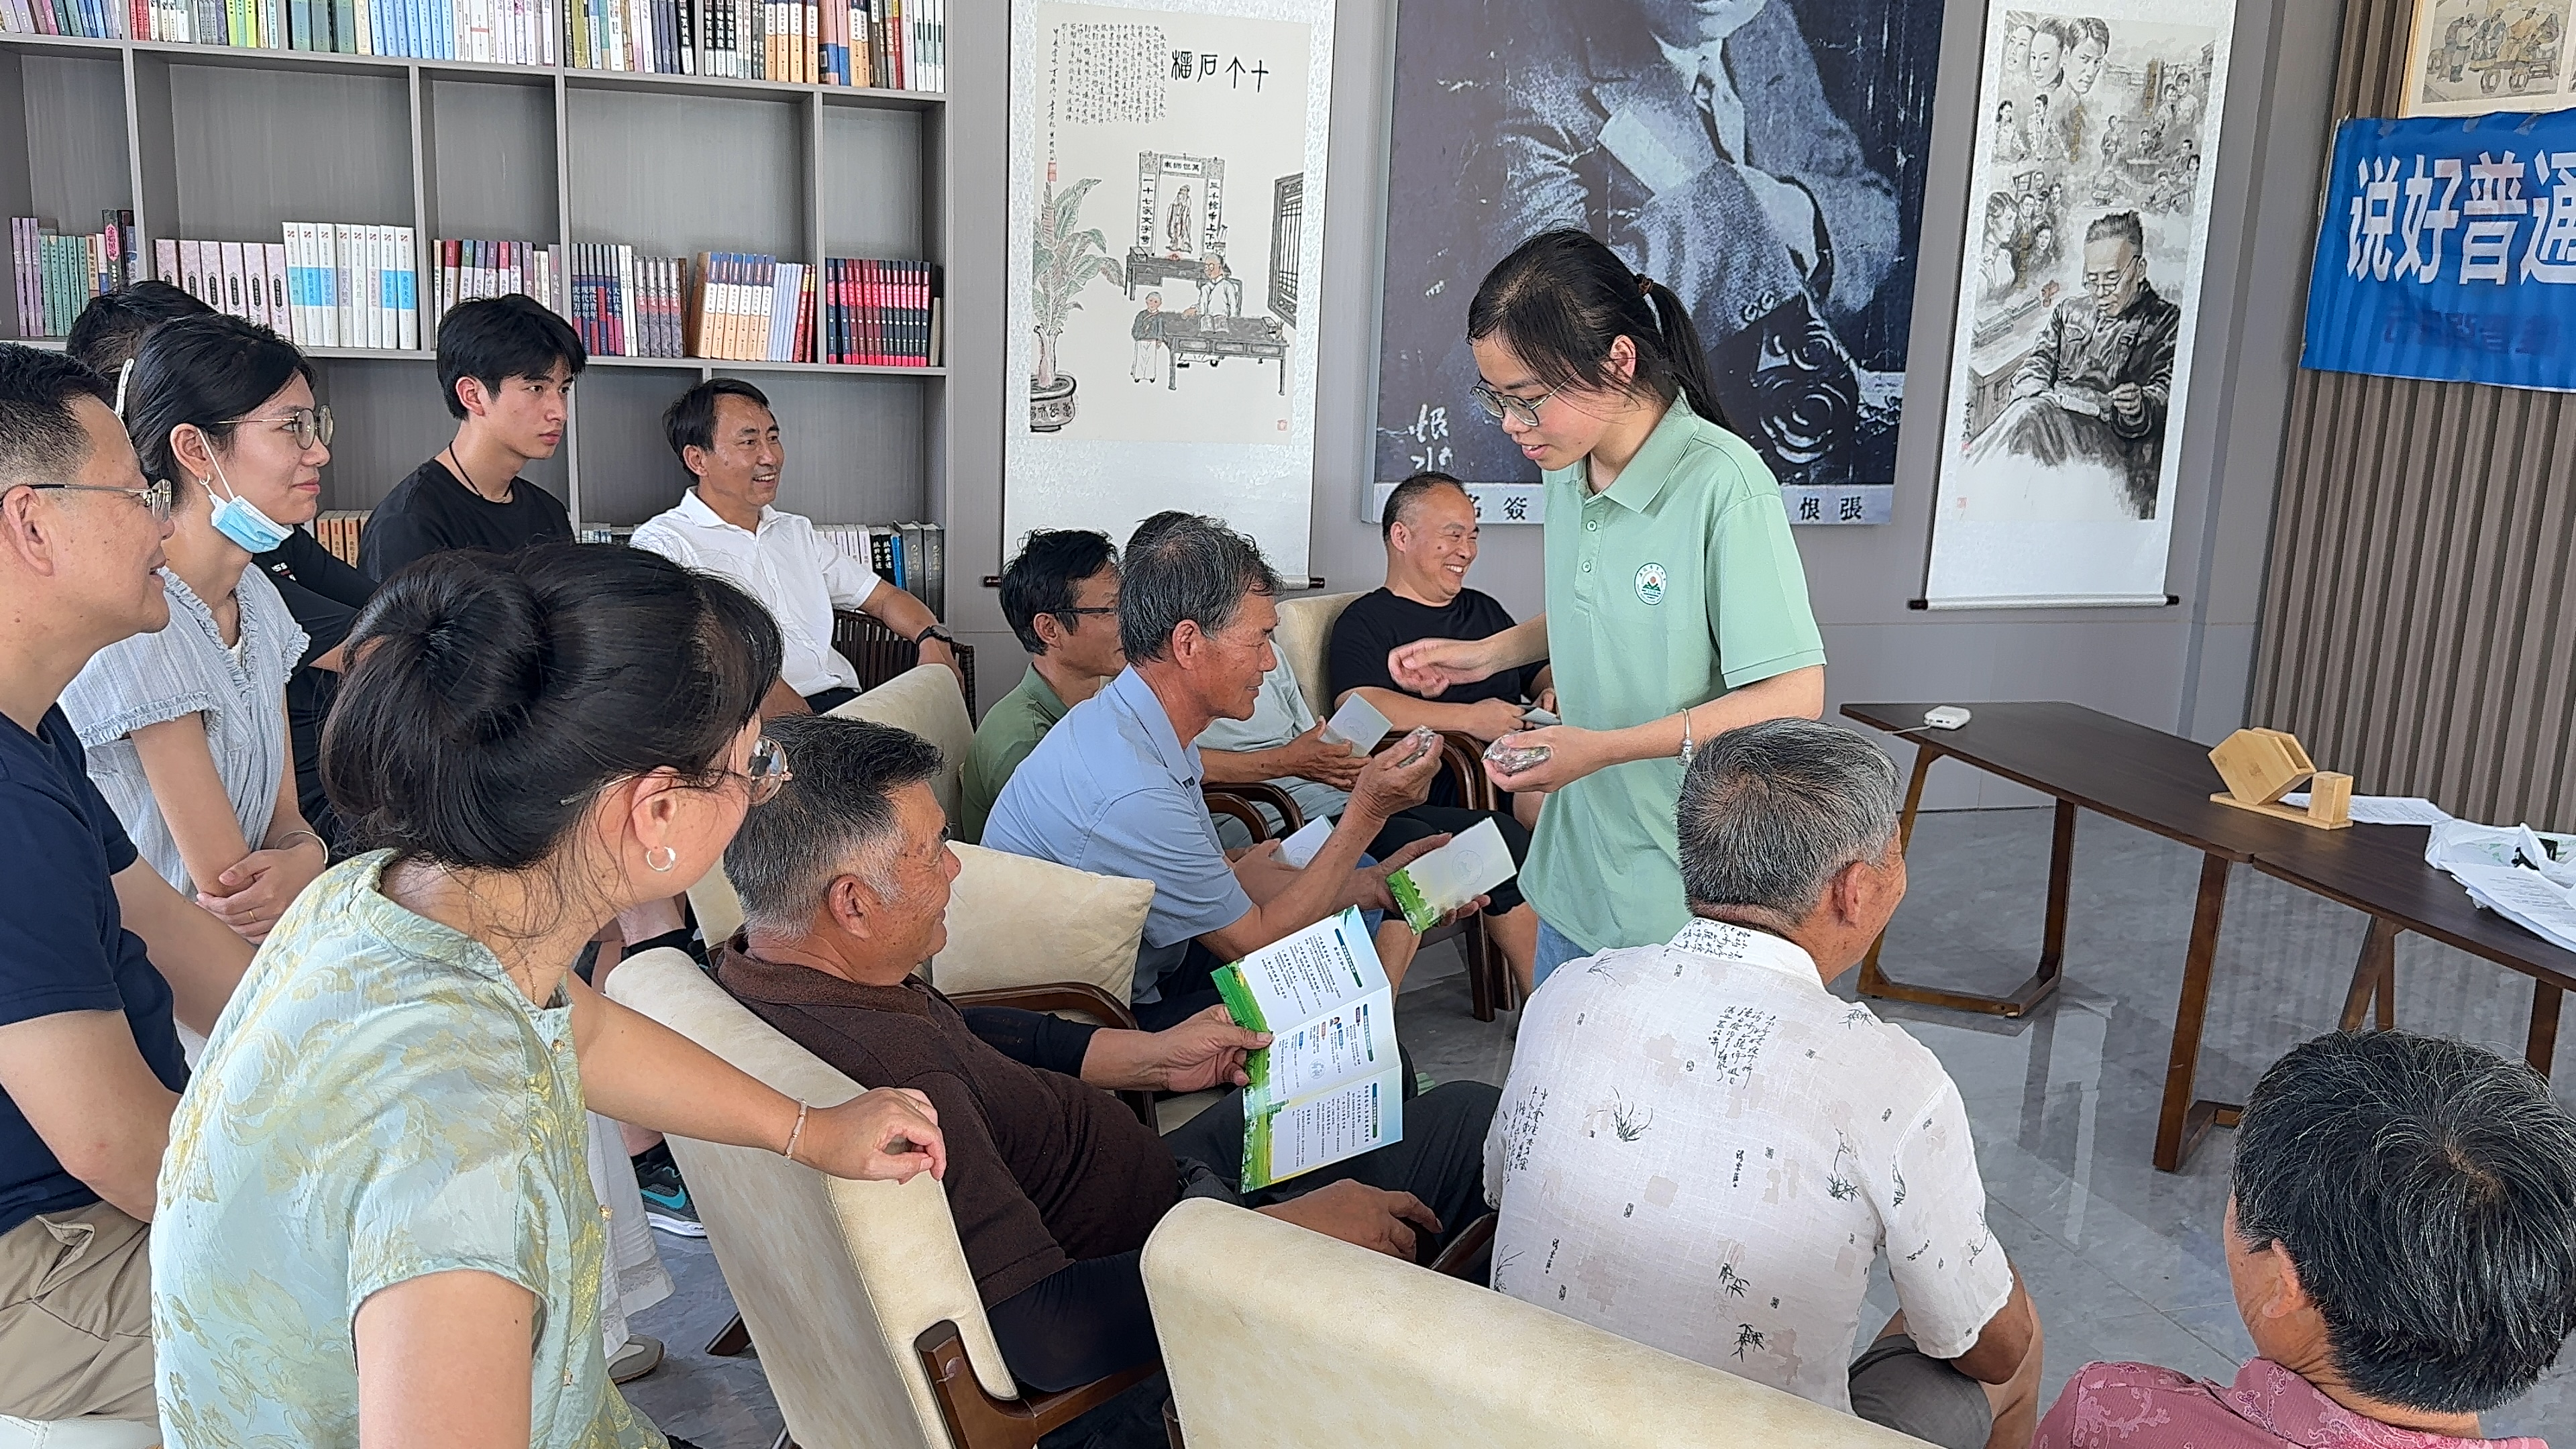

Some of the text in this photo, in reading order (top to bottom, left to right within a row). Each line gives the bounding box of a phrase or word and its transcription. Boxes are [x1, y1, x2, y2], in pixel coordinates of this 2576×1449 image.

[2347, 150, 2576, 286] 说好普通
[1799, 494, 1863, 521] 張恨
